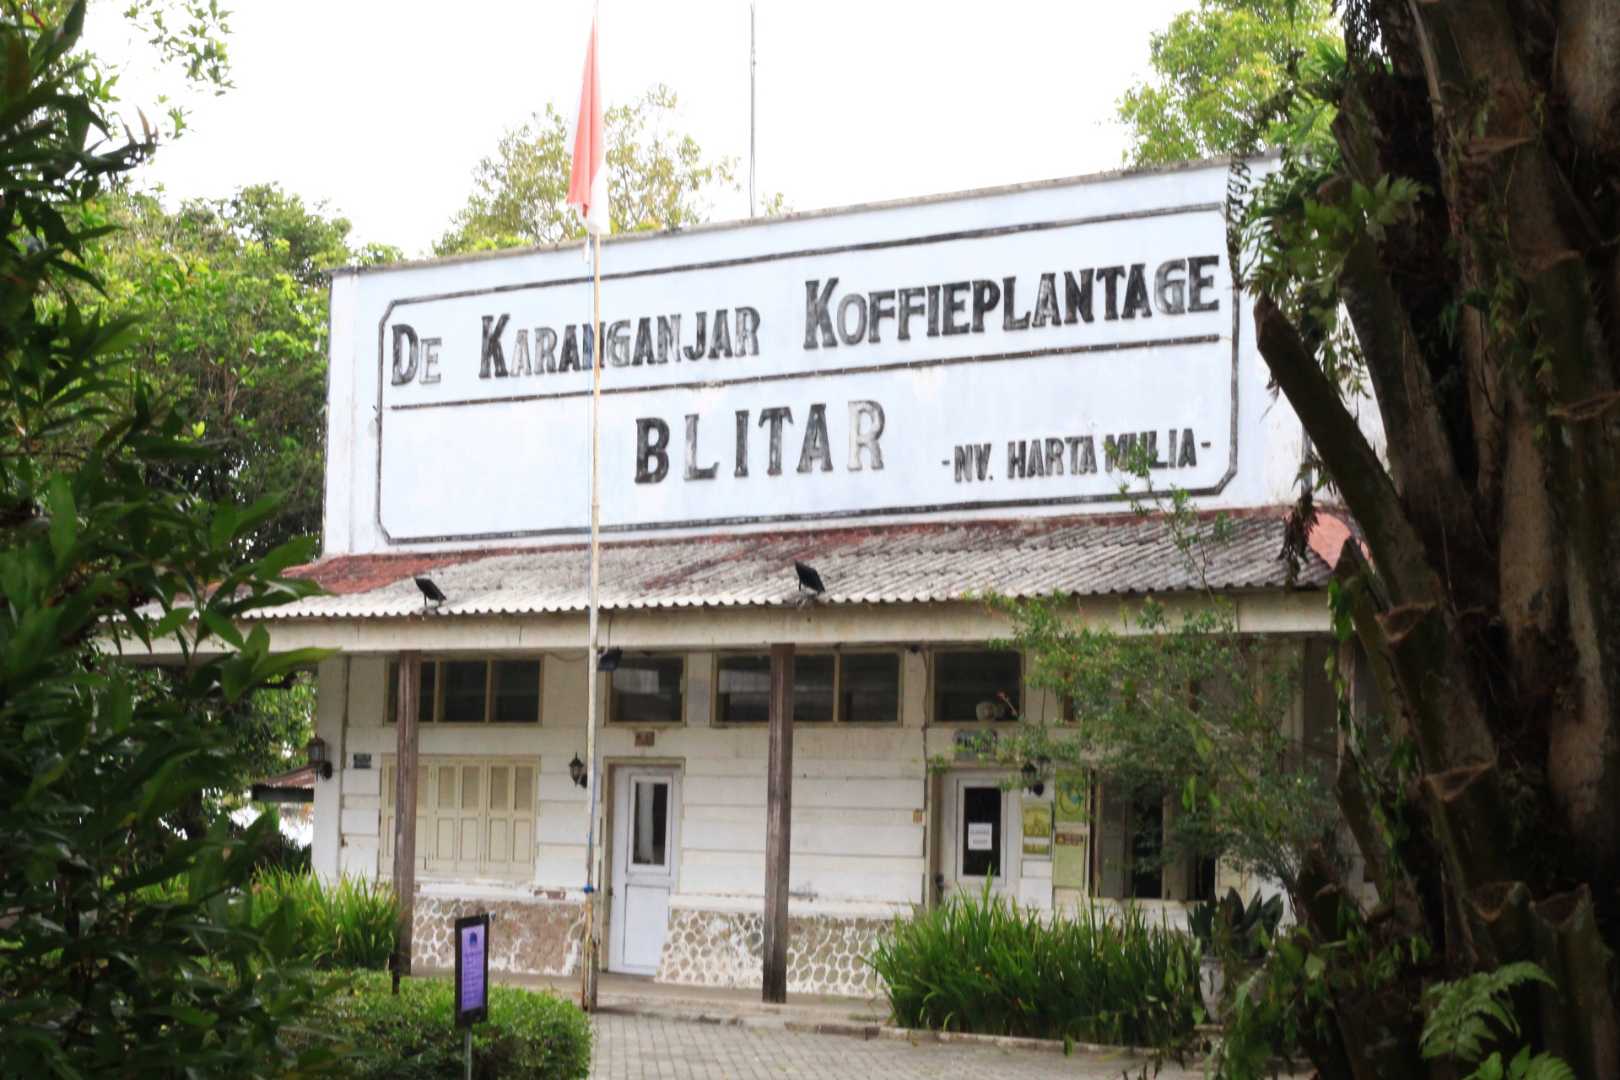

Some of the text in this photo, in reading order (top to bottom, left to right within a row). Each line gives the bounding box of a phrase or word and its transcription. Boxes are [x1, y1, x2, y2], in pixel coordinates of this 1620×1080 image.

[391, 255, 1220, 386] DE KARANGANJAR KOFFIEPLANTAGE
[635, 400, 886, 484] BLITAR
[1007, 435, 1098, 480] HARTA
